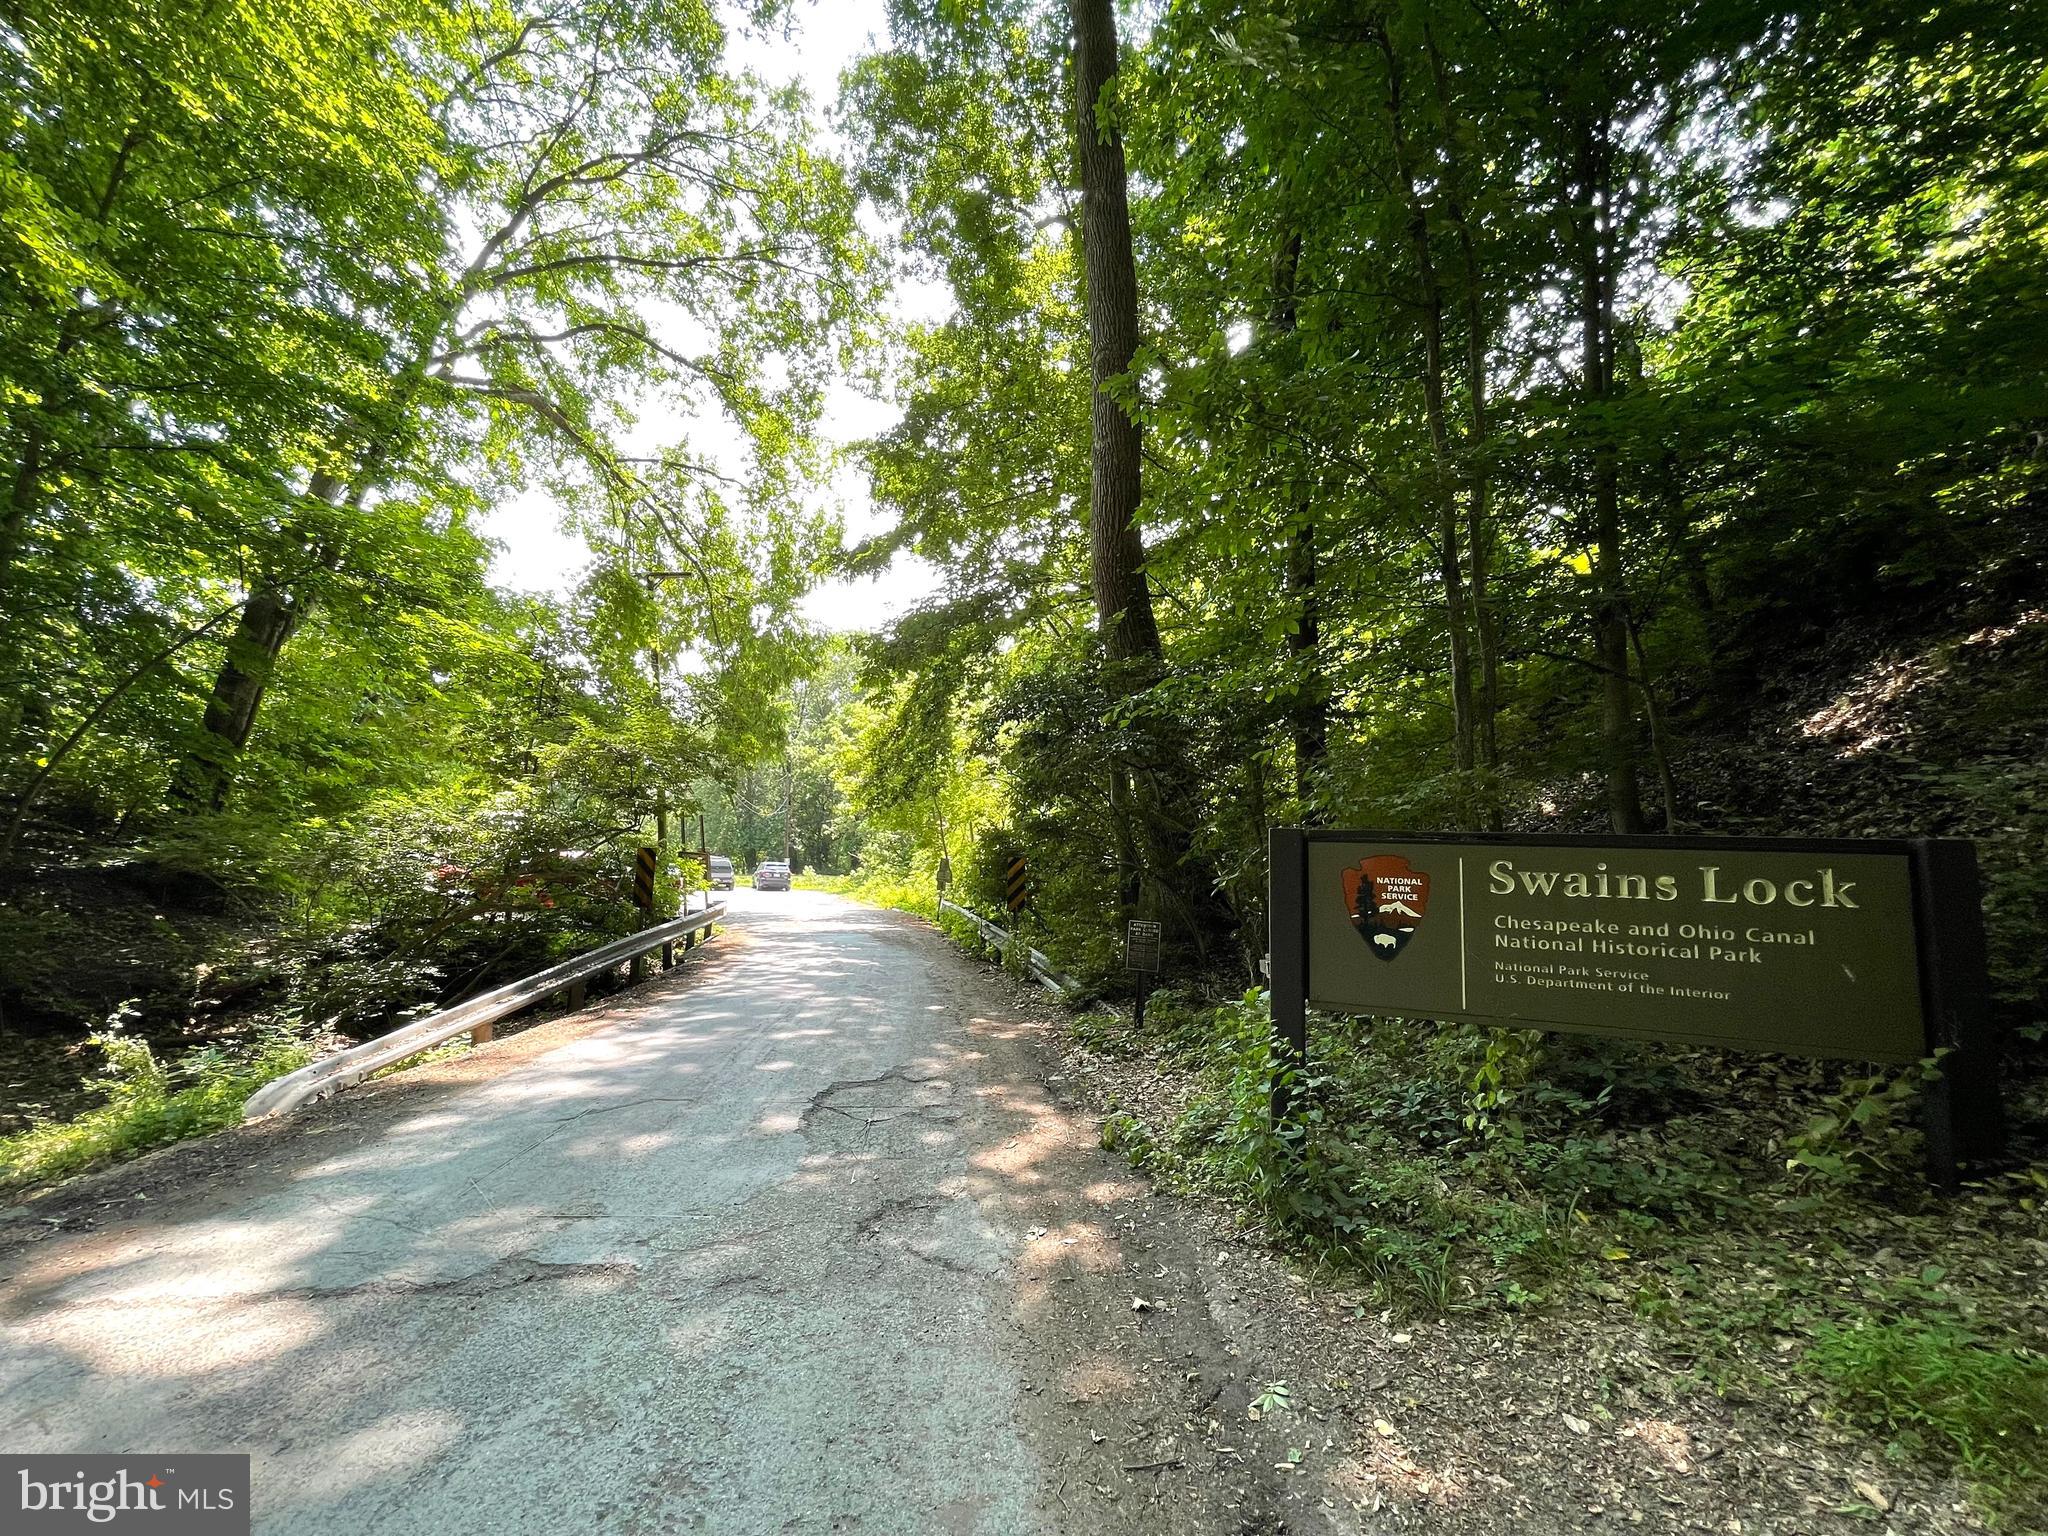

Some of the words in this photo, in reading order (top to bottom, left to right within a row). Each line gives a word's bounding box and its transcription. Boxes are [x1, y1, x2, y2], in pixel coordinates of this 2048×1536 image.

[1376, 876, 1423, 886] NATIONAL
[1387, 884, 1411, 893] PARK
[1488, 859, 1678, 901] Swains
[1698, 865, 1860, 909] Lock
[1381, 892, 1418, 901] SERVICE
[1494, 915, 1620, 935] Chesapeake
[1628, 922, 1669, 938] and
[1678, 923, 1736, 942] Ohio
[1745, 927, 1815, 945] Canal
[1494, 933, 1584, 953] National
[1592, 938, 1699, 960] Historical
[1709, 946, 1762, 964] Park
[1494, 961, 1554, 976] National
[1558, 964, 1590, 977] Park
[1595, 967, 1650, 981] Service
[1494, 973, 1521, 985] U.S.
[1527, 975, 1614, 992] Department
[1618, 981, 1634, 993] of
[1640, 983, 1664, 995] the
[1669, 986, 1732, 1000] Interior
